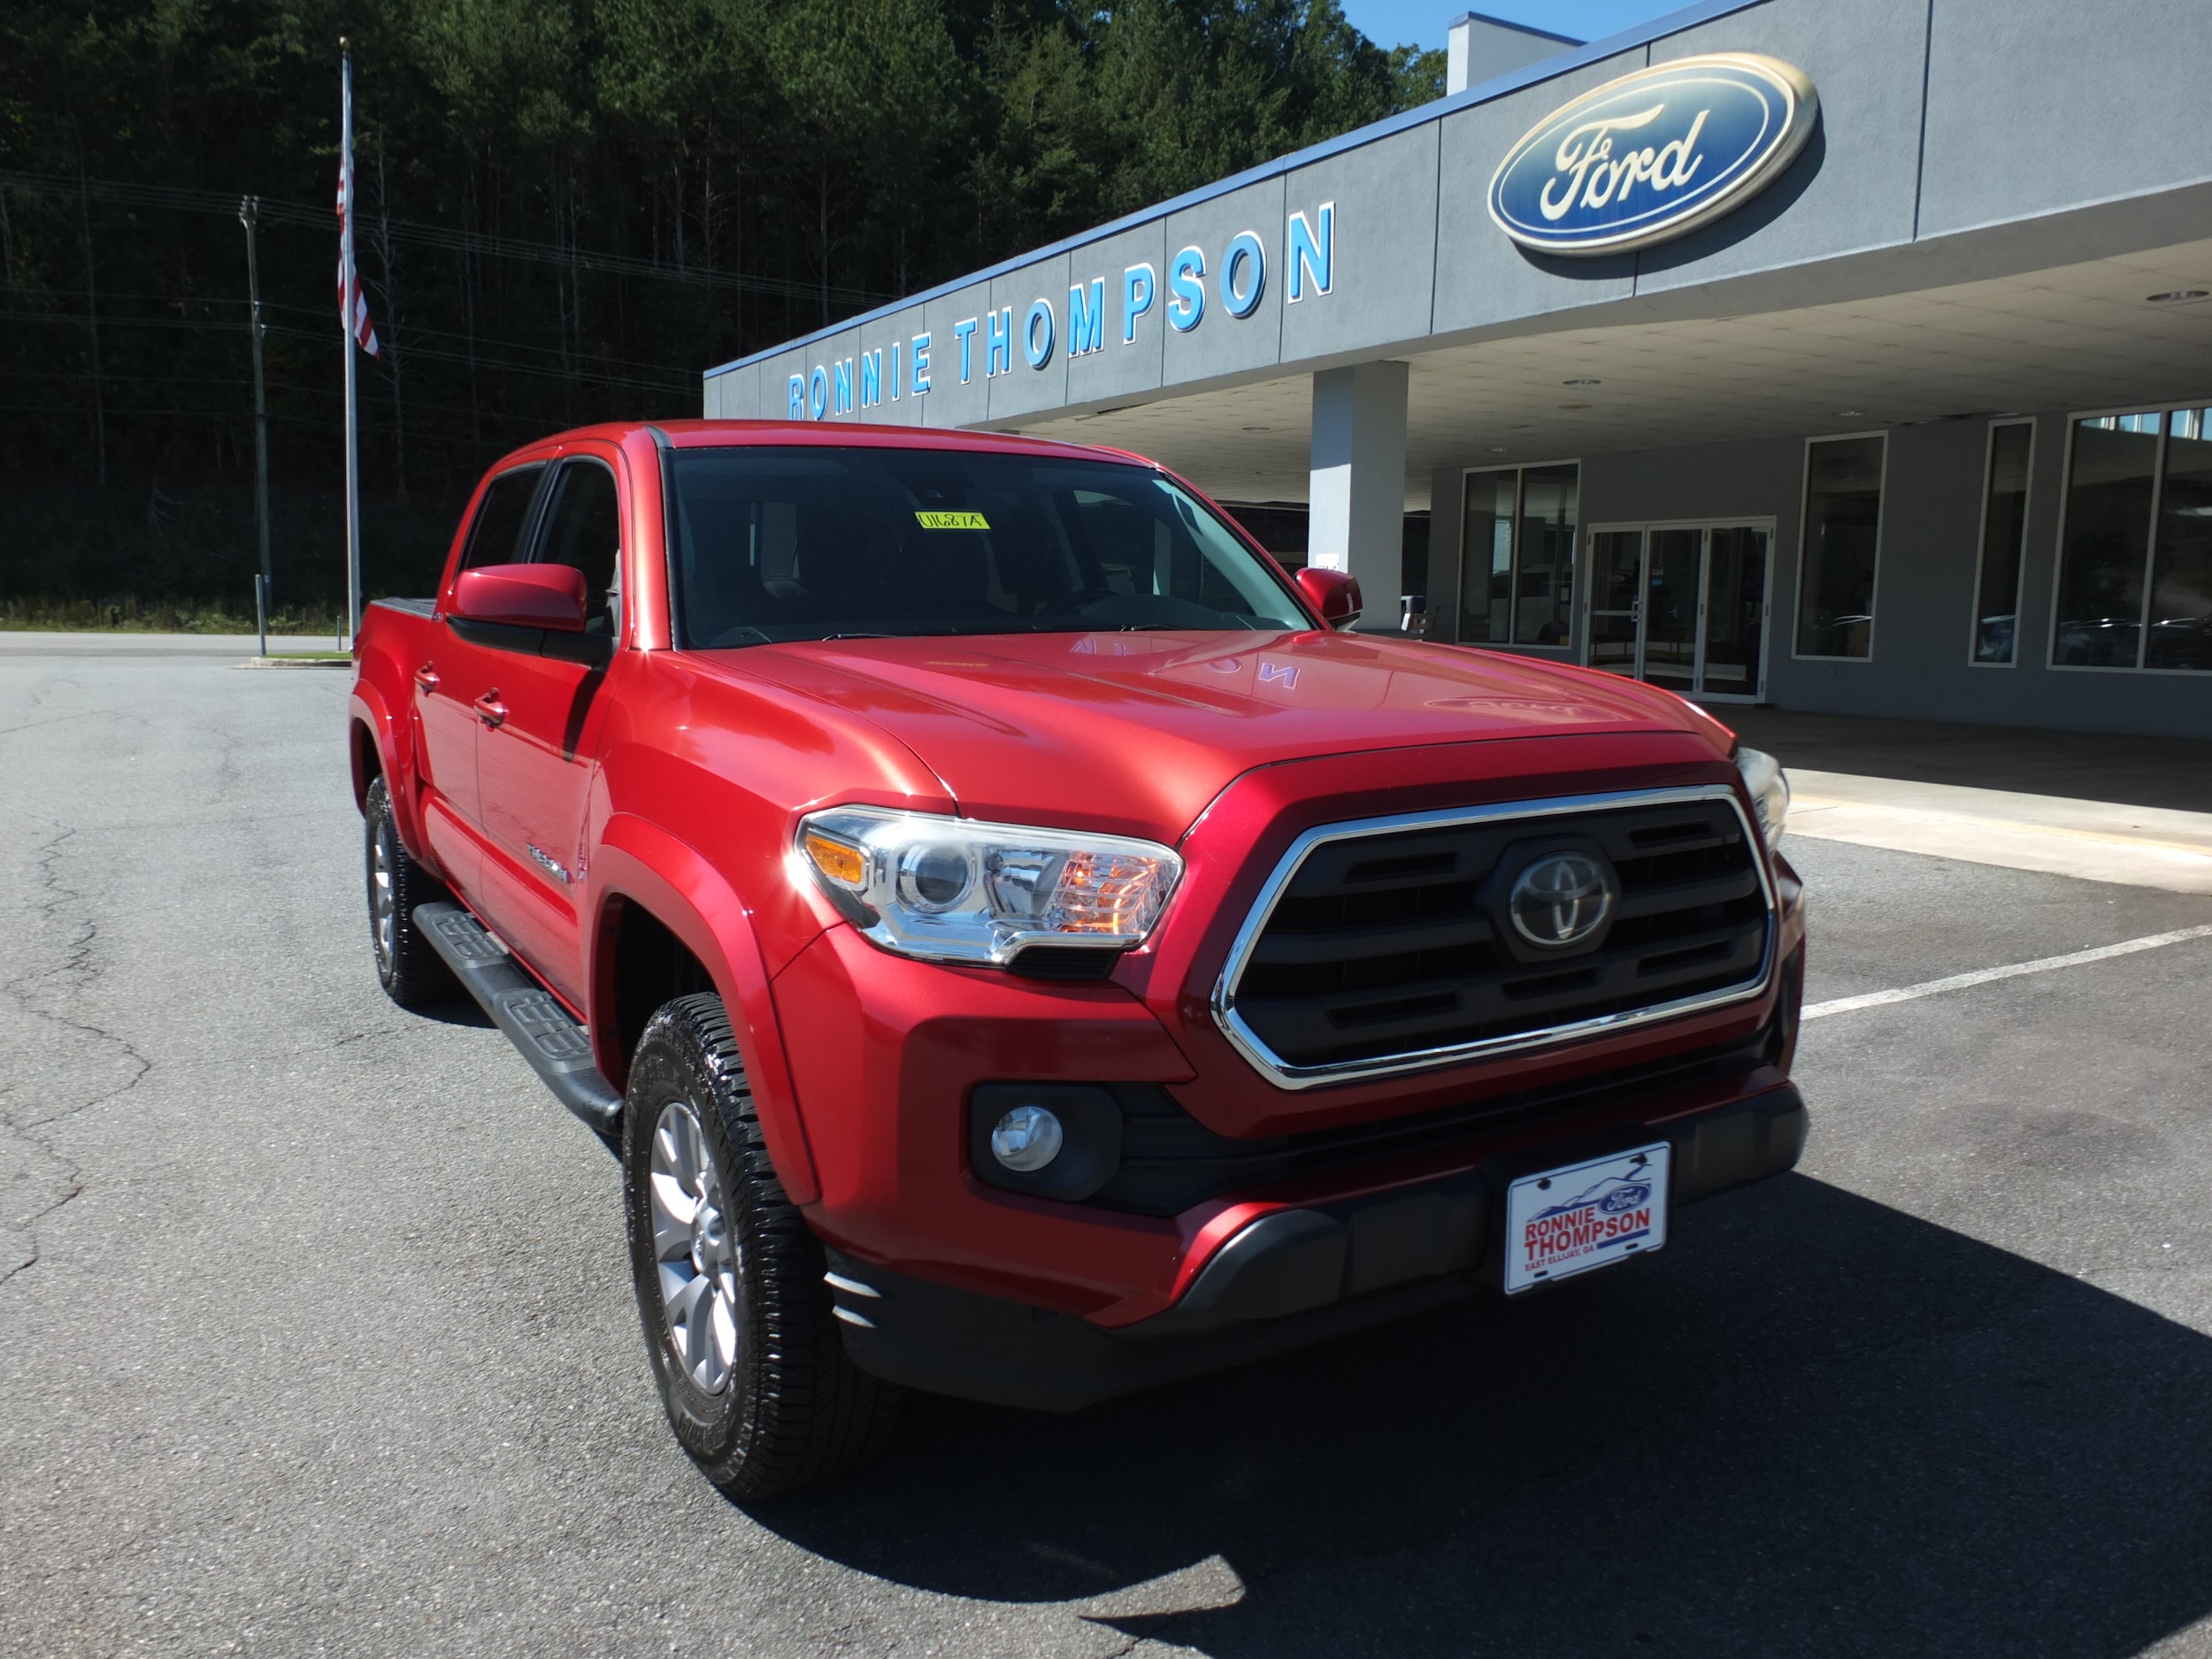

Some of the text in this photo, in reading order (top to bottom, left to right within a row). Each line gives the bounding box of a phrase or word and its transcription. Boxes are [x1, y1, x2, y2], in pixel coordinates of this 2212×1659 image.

[1540, 104, 1709, 220] Ford
[789, 201, 1335, 420] RONNIE THOMPSON
[1607, 1188, 1641, 1210] Ford
[1524, 1208, 1650, 1261] THOMPSON
[1525, 1206, 1595, 1241] RONNIE
[1525, 1259, 1547, 1271] EAST
[1583, 1245, 1594, 1254] GA
